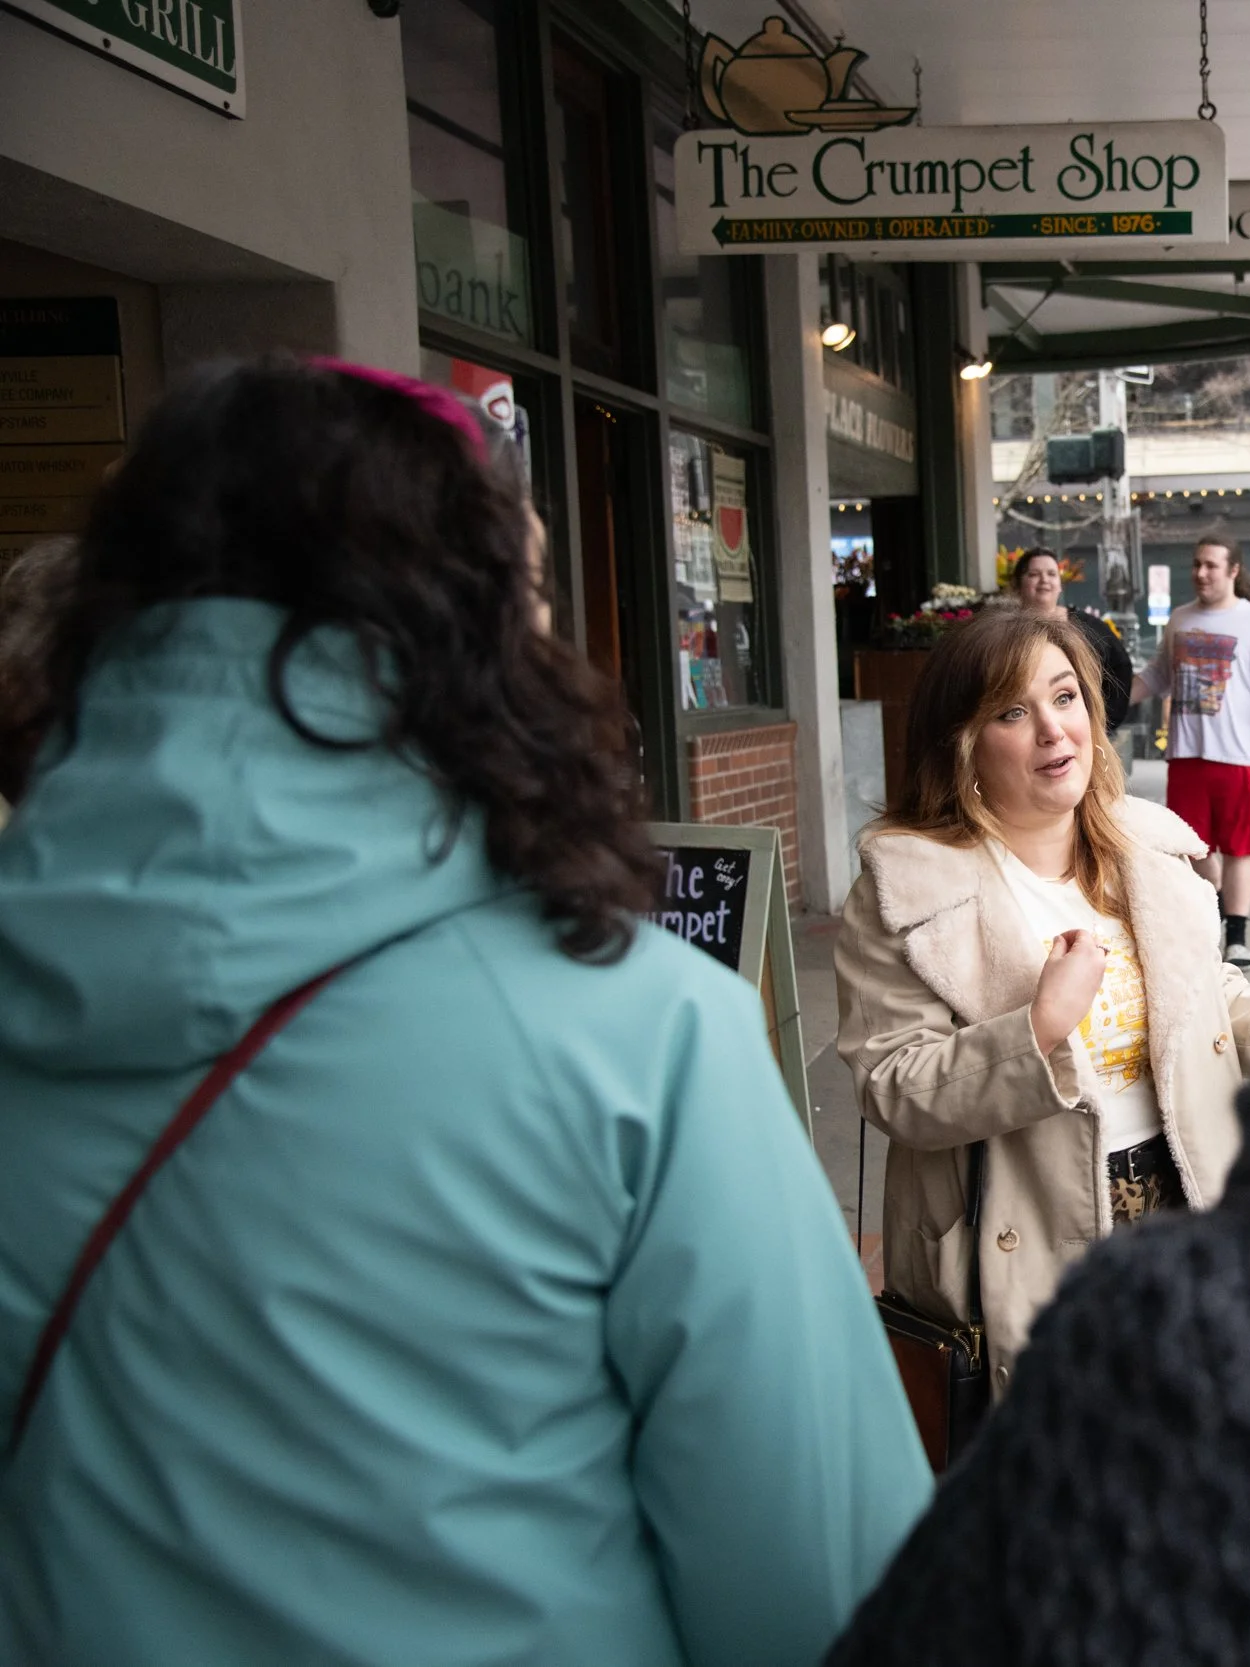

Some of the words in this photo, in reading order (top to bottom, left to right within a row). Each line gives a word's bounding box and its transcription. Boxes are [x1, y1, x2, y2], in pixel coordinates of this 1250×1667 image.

[120, 0, 236, 78] GRILL
[697, 140, 798, 208] The
[812, 136, 1036, 213] Crumpet
[1057, 132, 1200, 208] Shop
[1112, 213, 1155, 233] 1976
[18, 387, 73, 401] COMPANY
[36, 458, 86, 473] WHISKEY
[653, 851, 704, 900] he
[713, 857, 736, 874] Get
[646, 900, 731, 944] mpet
